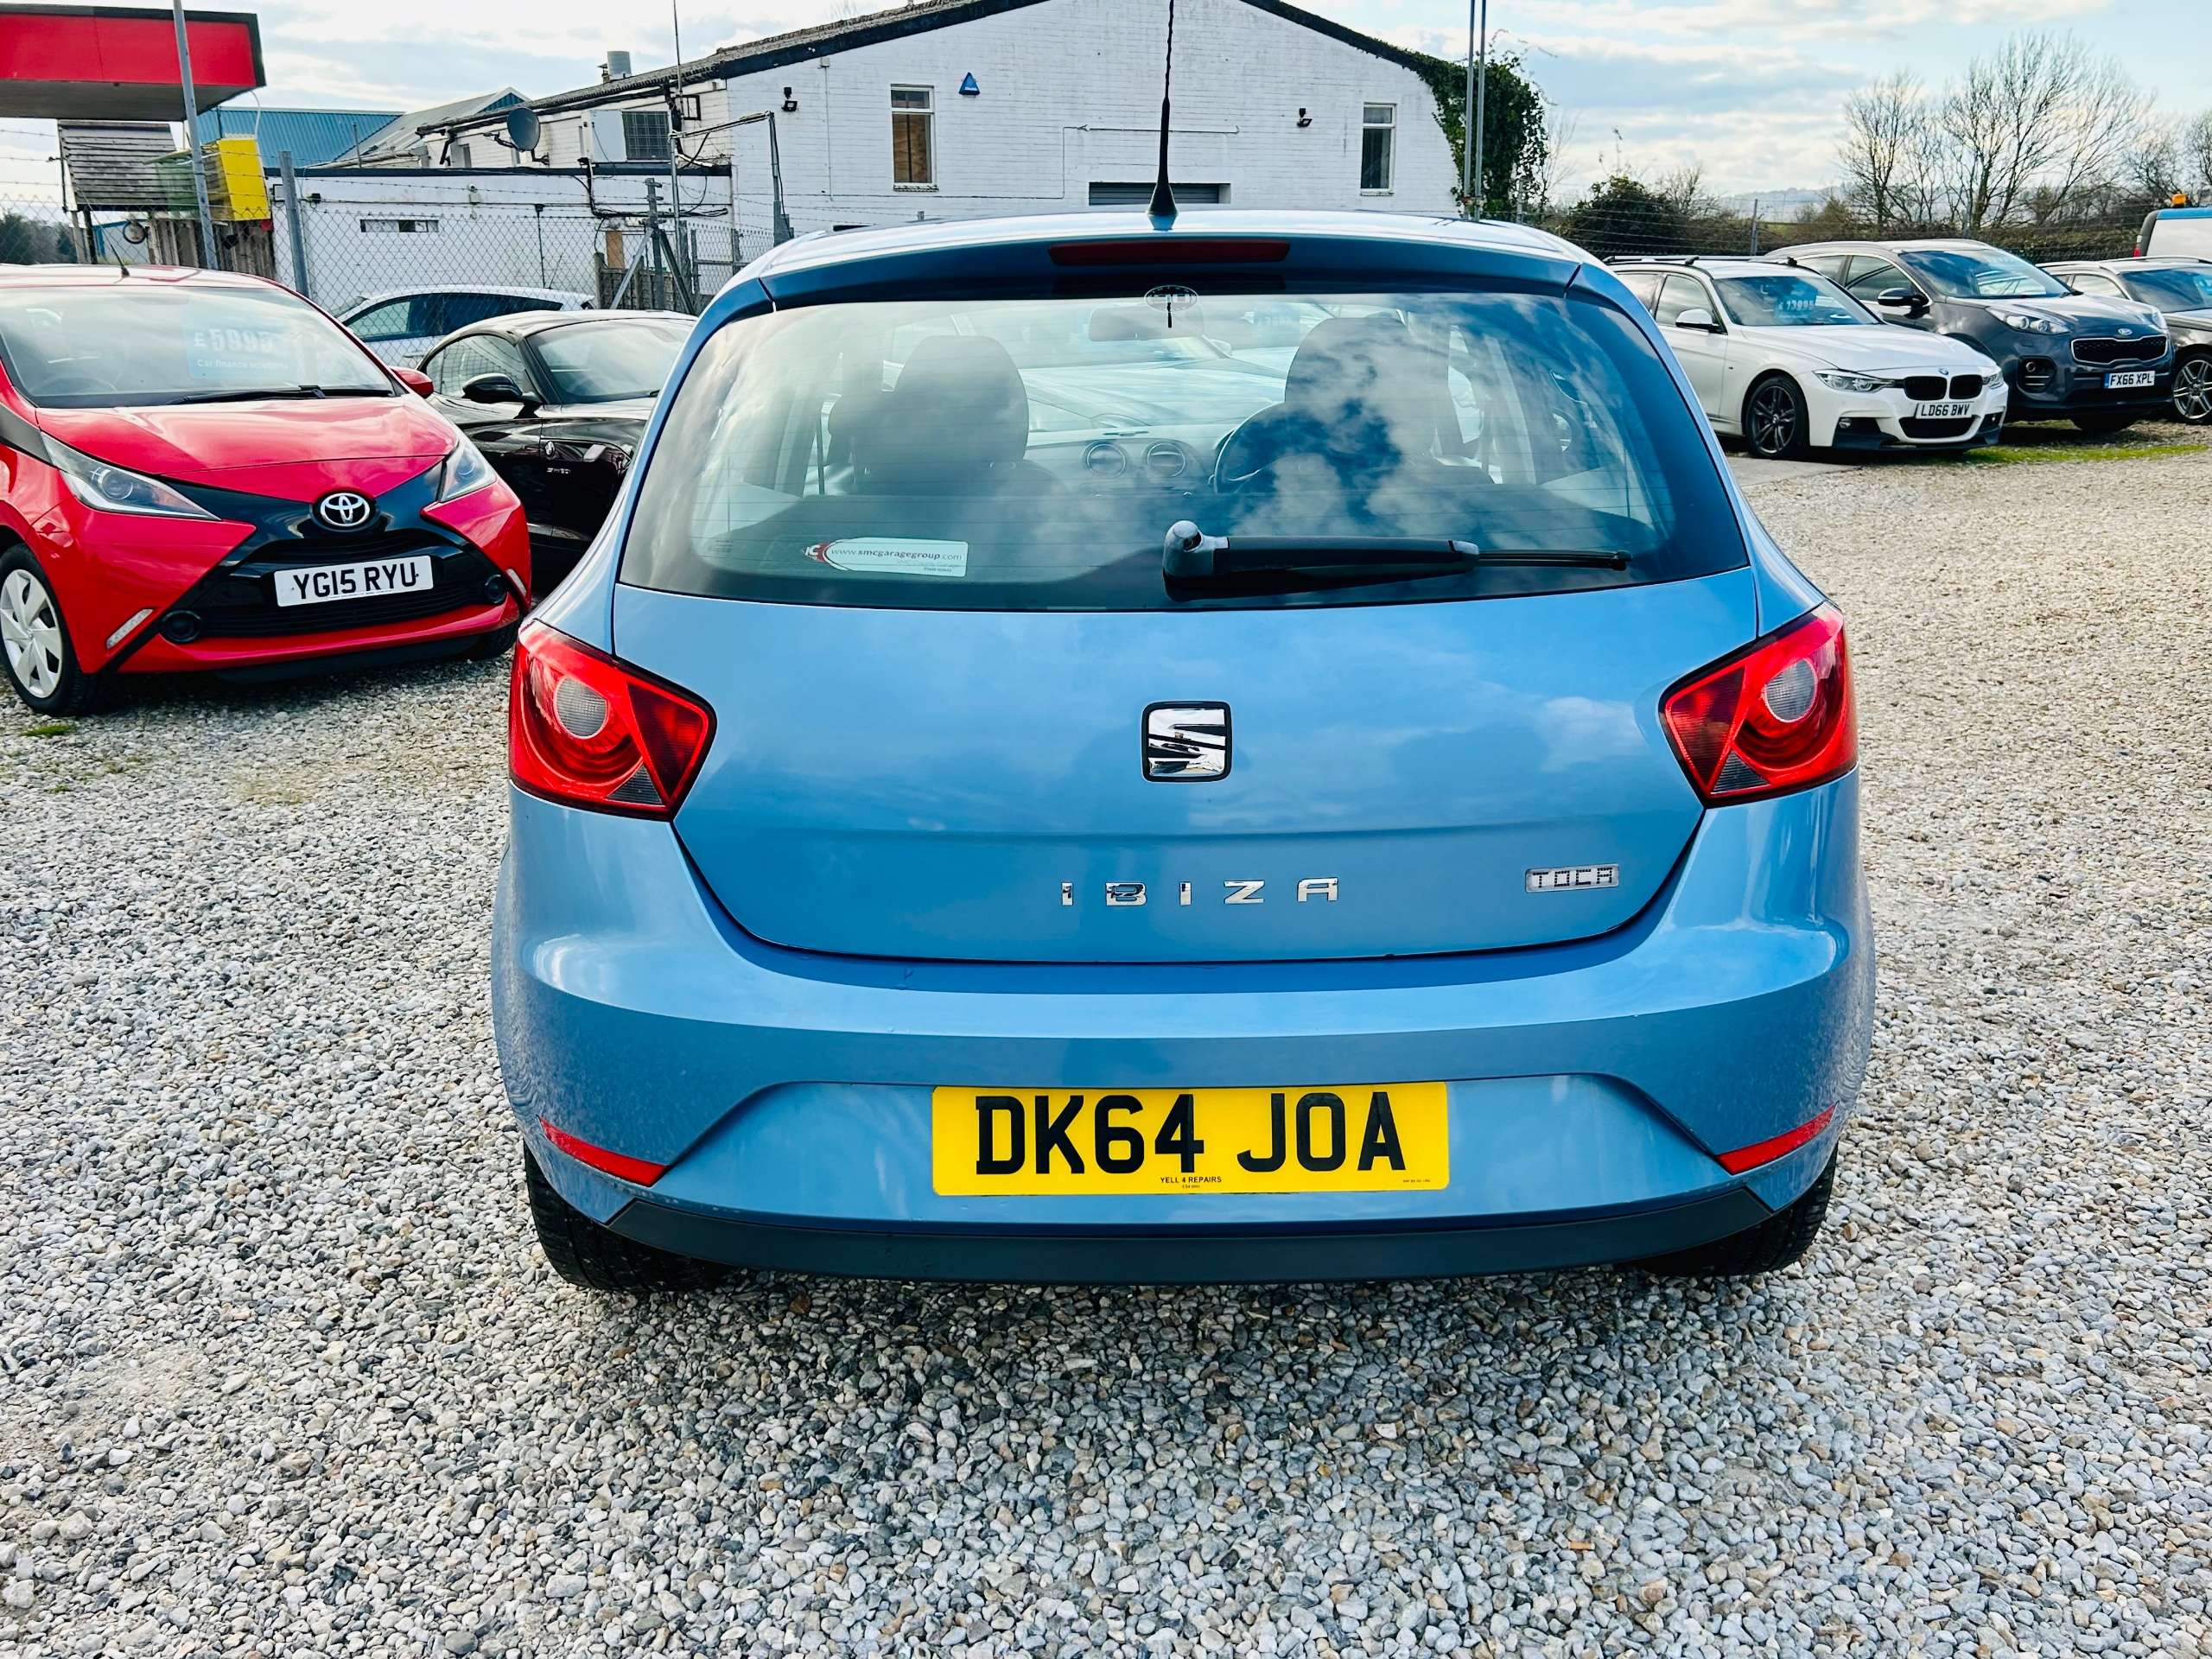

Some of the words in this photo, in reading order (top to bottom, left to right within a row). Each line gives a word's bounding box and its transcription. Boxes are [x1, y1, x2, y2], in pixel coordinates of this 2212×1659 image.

[2110, 374, 2134, 385] FX66
[2136, 372, 2152, 384] XPL
[1921, 404, 1948, 416] LD66
[831, 548, 962, 560] www.smcgaragegroup.com
[293, 569, 357, 600] YG15
[364, 563, 416, 592] RYU
[1532, 867, 1613, 888] TOCA
[1061, 877, 1338, 906] IBIZA
[976, 1093, 1205, 1175] DK64
[1236, 1091, 1406, 1173] JOA
